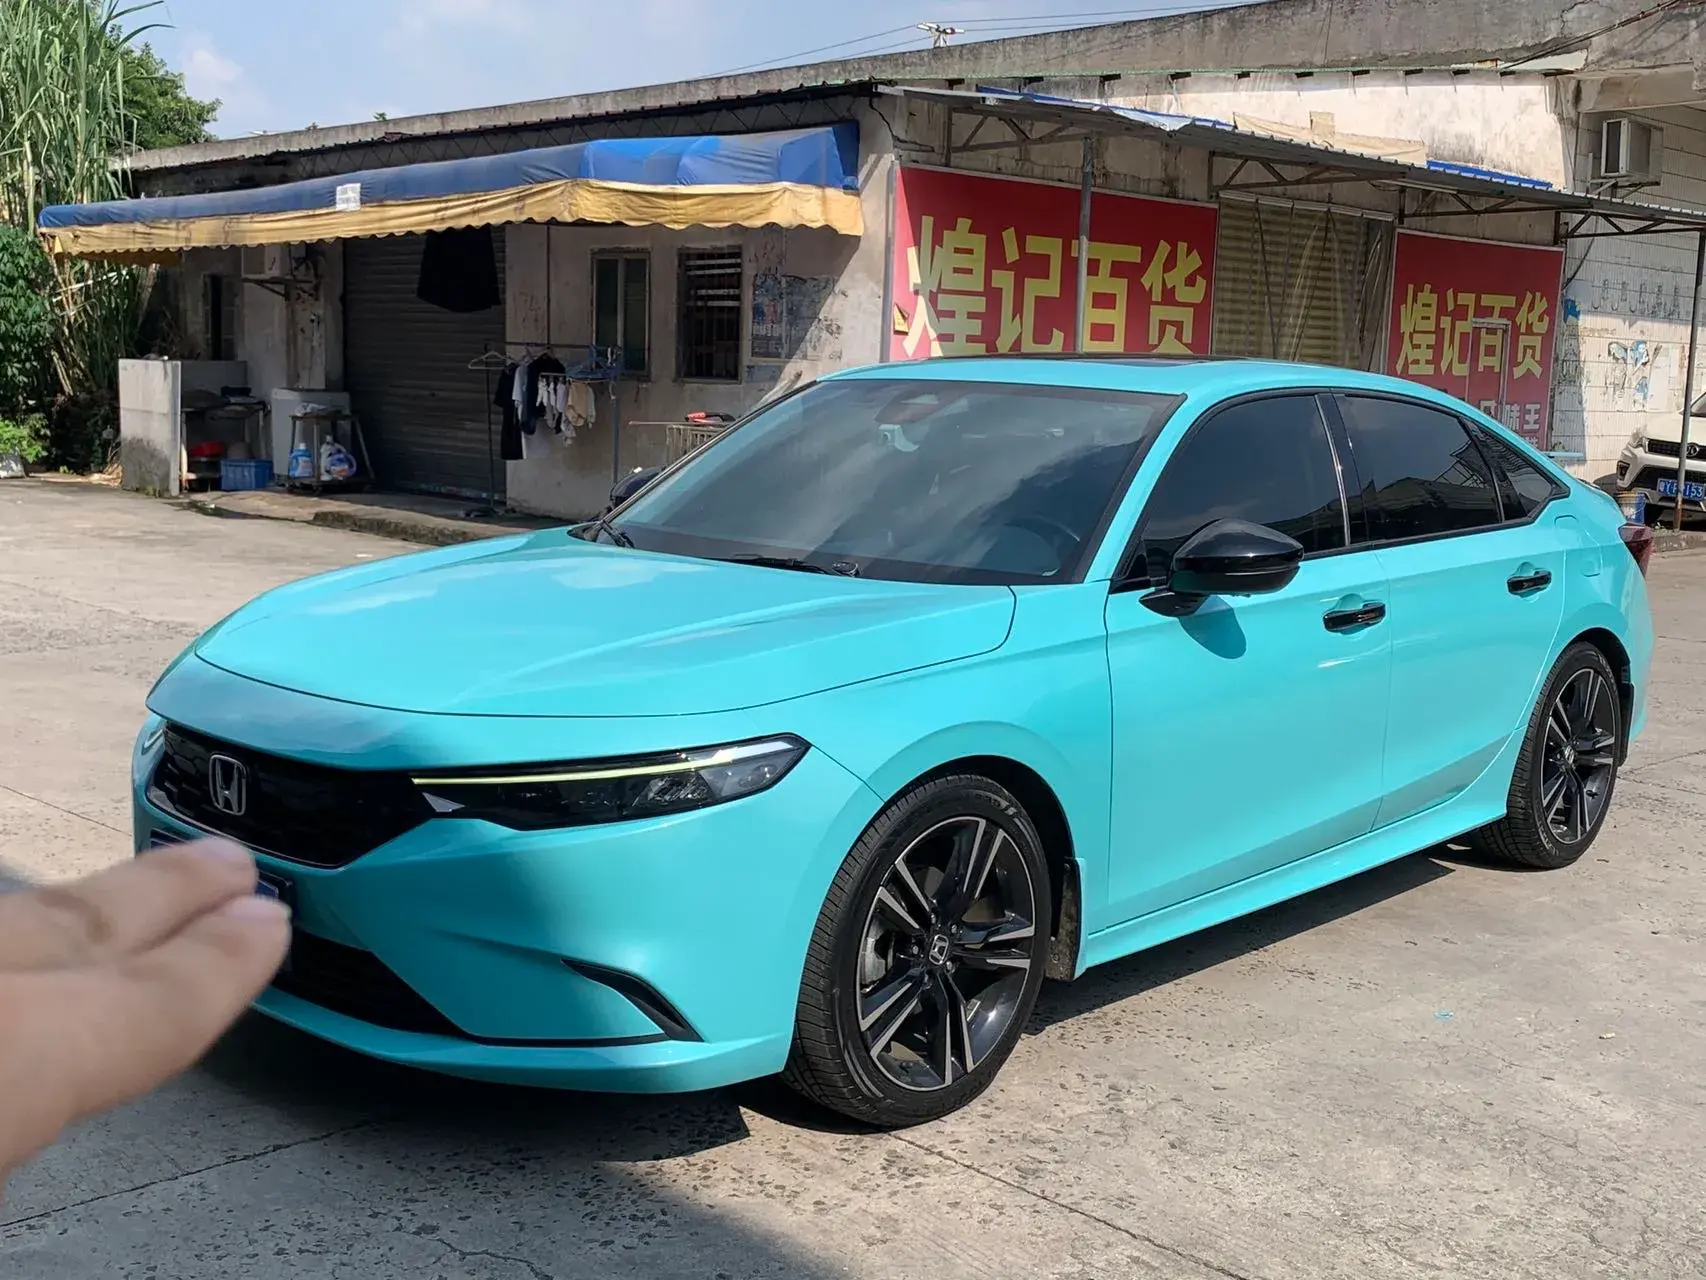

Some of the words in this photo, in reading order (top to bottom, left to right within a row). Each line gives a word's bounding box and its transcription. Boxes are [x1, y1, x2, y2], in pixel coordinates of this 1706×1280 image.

[902, 215, 1207, 356] 煌记百货
[1396, 284, 1549, 379] 煌记百货
